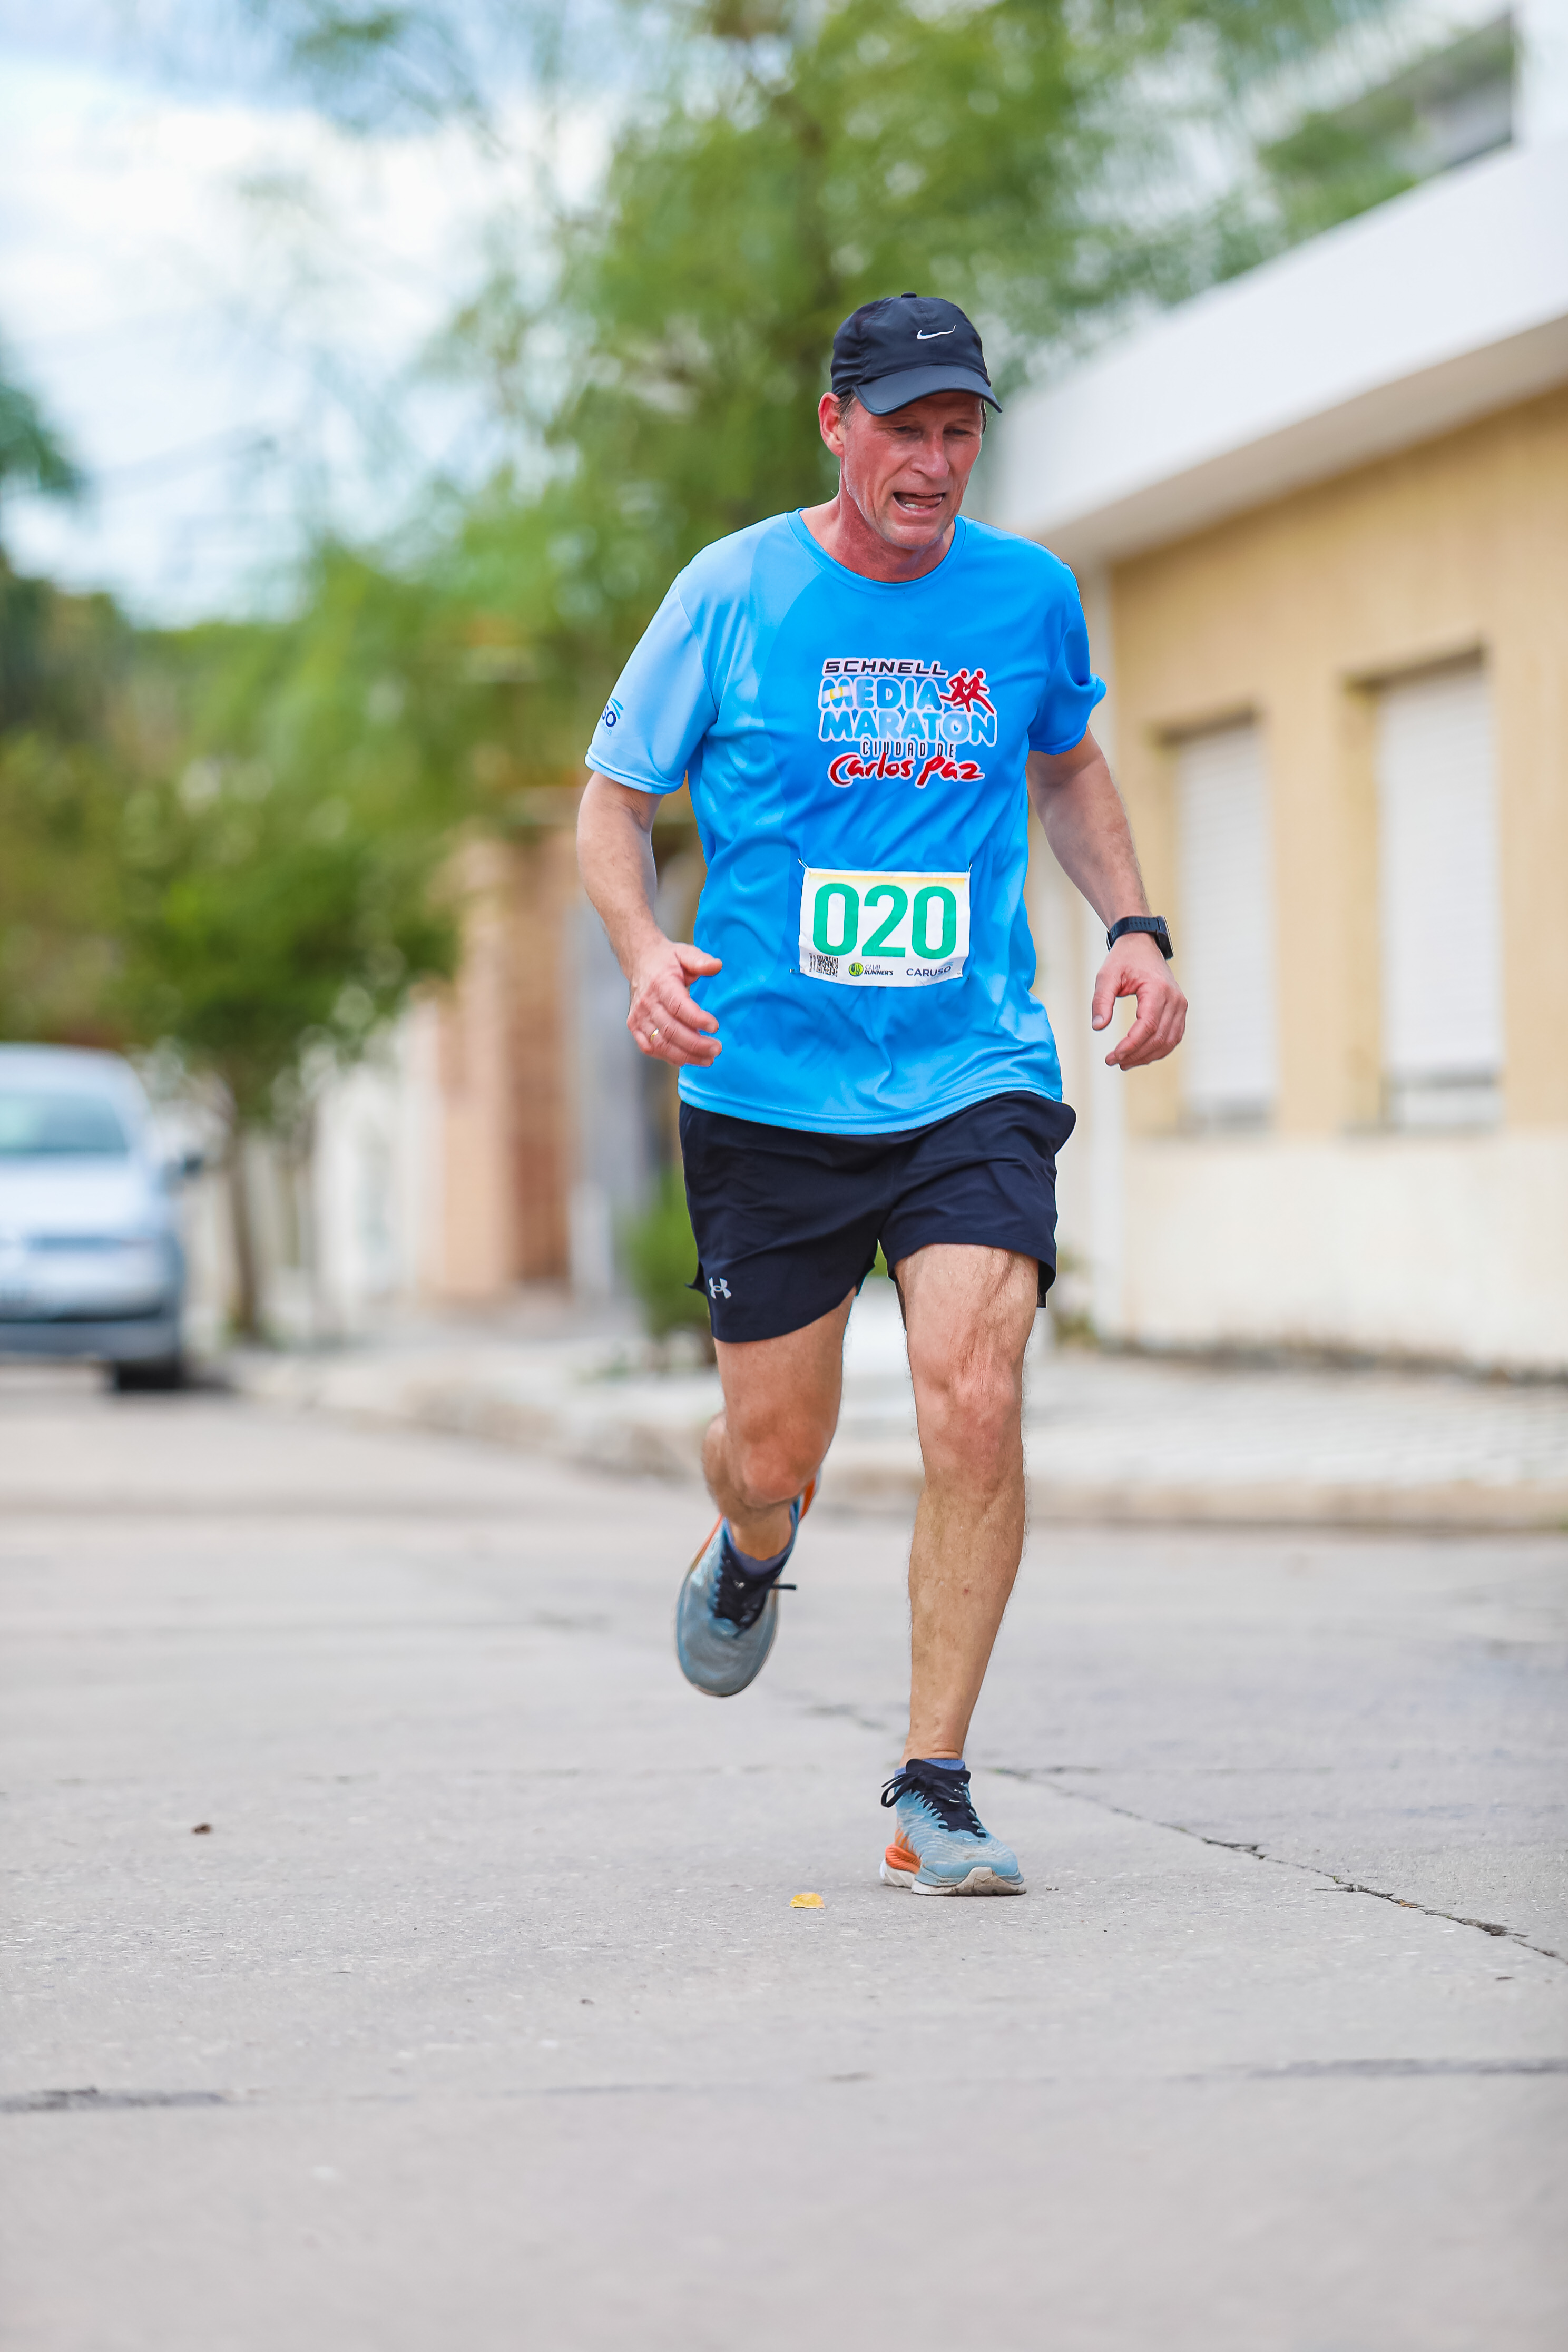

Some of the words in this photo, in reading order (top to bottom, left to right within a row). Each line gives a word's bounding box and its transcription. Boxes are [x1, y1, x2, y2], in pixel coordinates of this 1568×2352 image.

[825, 660, 946, 676] SCHNELL
[819, 677, 944, 710] MEDIA
[819, 710, 997, 746] MARATON
[863, 741, 926, 757] CIUDAD
[937, 743, 955, 757] DE
[830, 752, 914, 785] Carlos
[916, 756, 984, 786] Paz
[812, 883, 957, 960] 020
[906, 965, 952, 977] CARUSO
